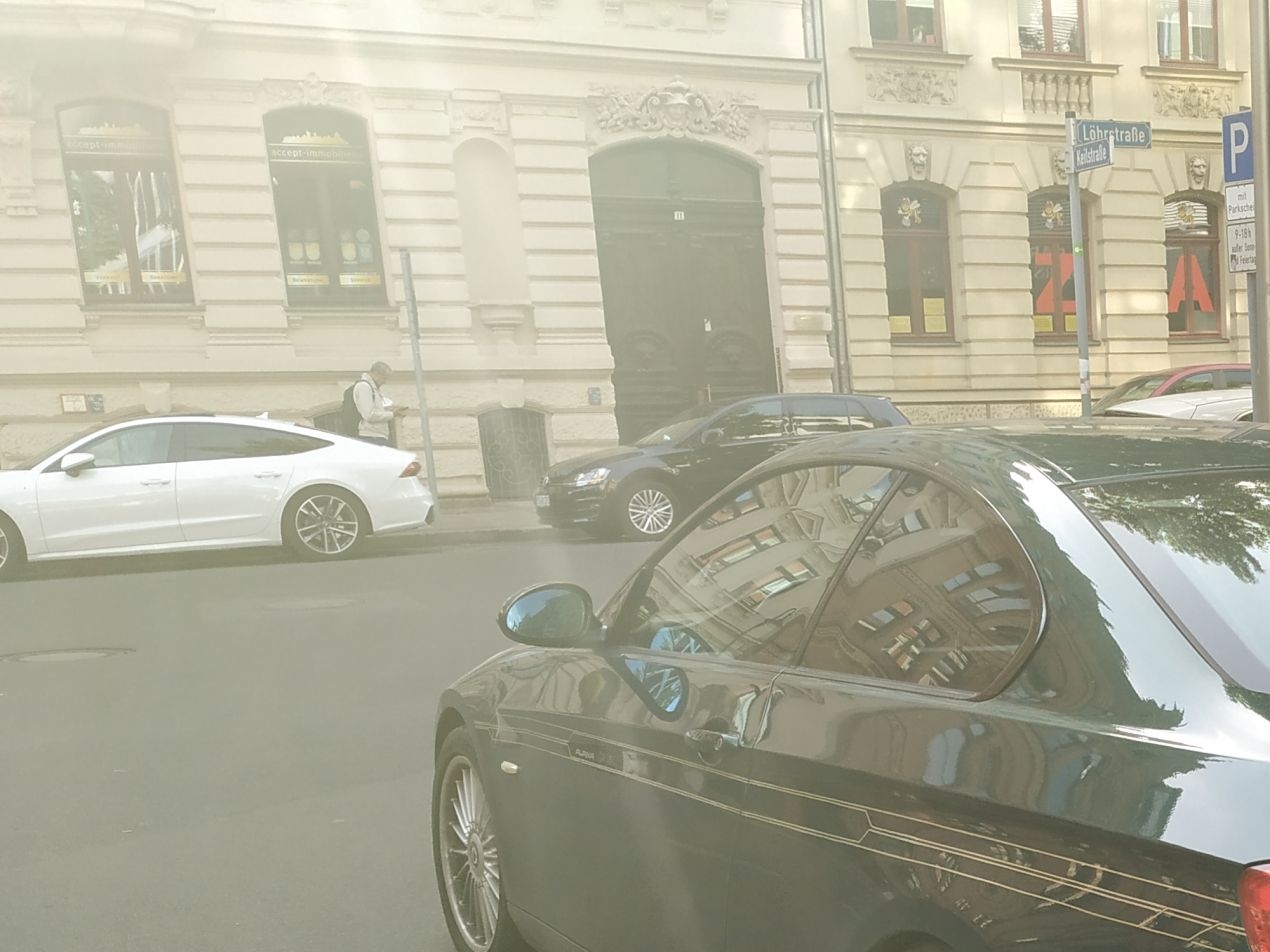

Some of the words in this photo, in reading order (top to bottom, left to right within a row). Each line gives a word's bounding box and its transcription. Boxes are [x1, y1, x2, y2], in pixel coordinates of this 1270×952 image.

[1082, 124, 1145, 143] Löhrstraße
[1076, 144, 1107, 166] Keilstraße
[1230, 121, 1249, 174] P
[1237, 192, 1247, 201] mit
